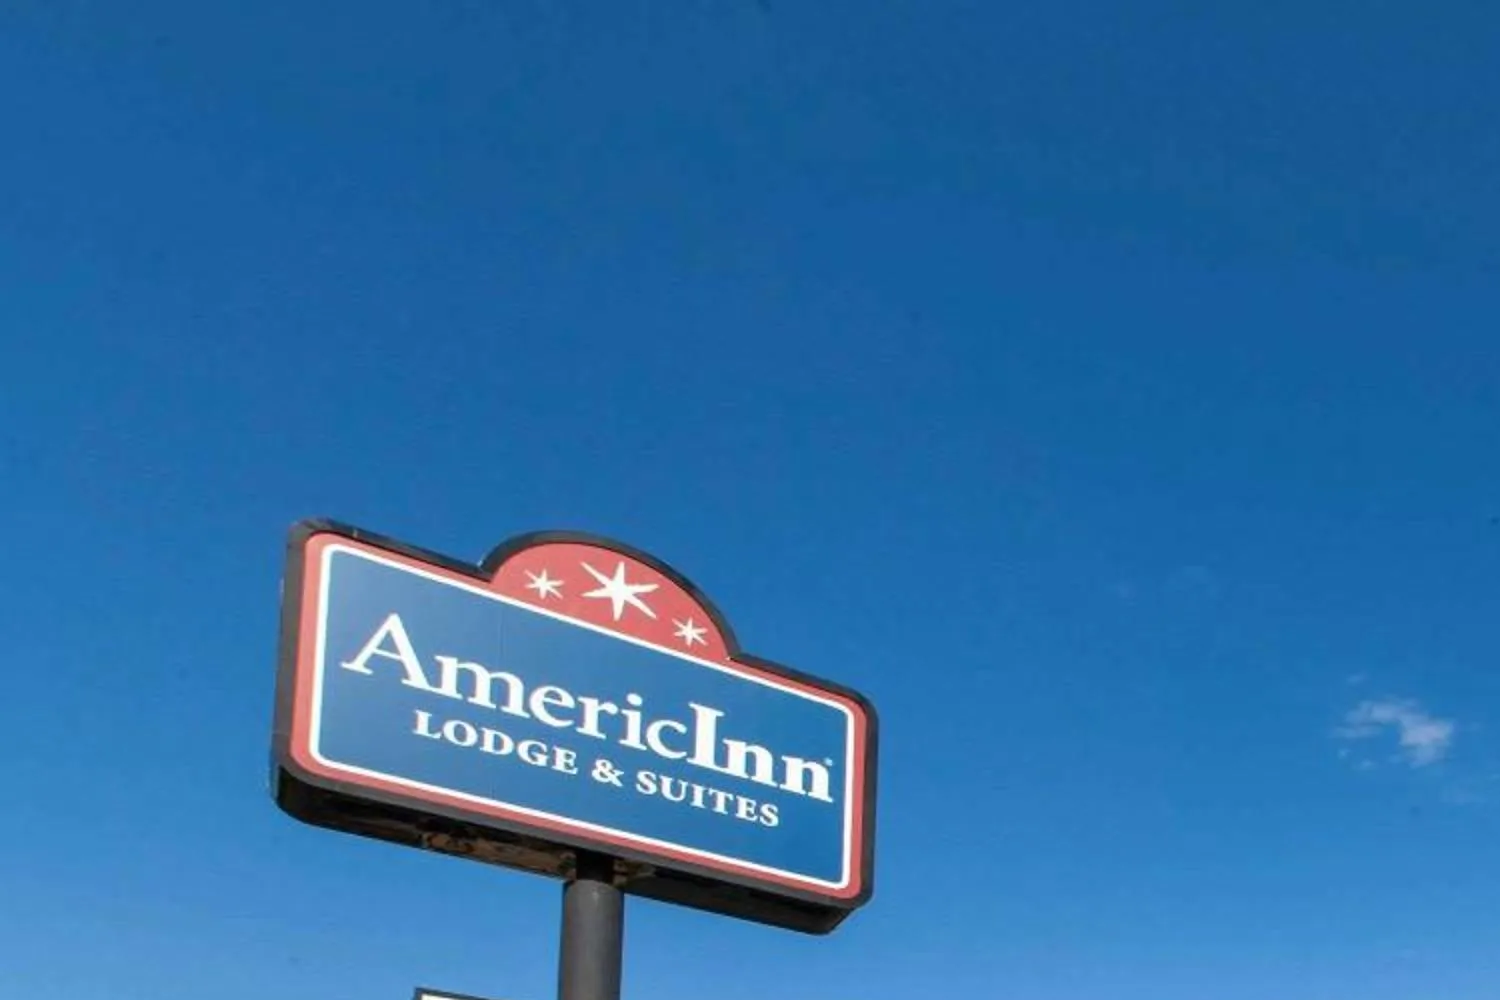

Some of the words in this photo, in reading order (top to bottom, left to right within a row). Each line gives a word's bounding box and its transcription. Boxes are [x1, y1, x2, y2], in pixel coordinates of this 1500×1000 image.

[340, 612, 834, 804] AmericInn
[414, 710, 578, 777] LODGE
[592, 752, 623, 787] &
[635, 770, 780, 828] SUITES
